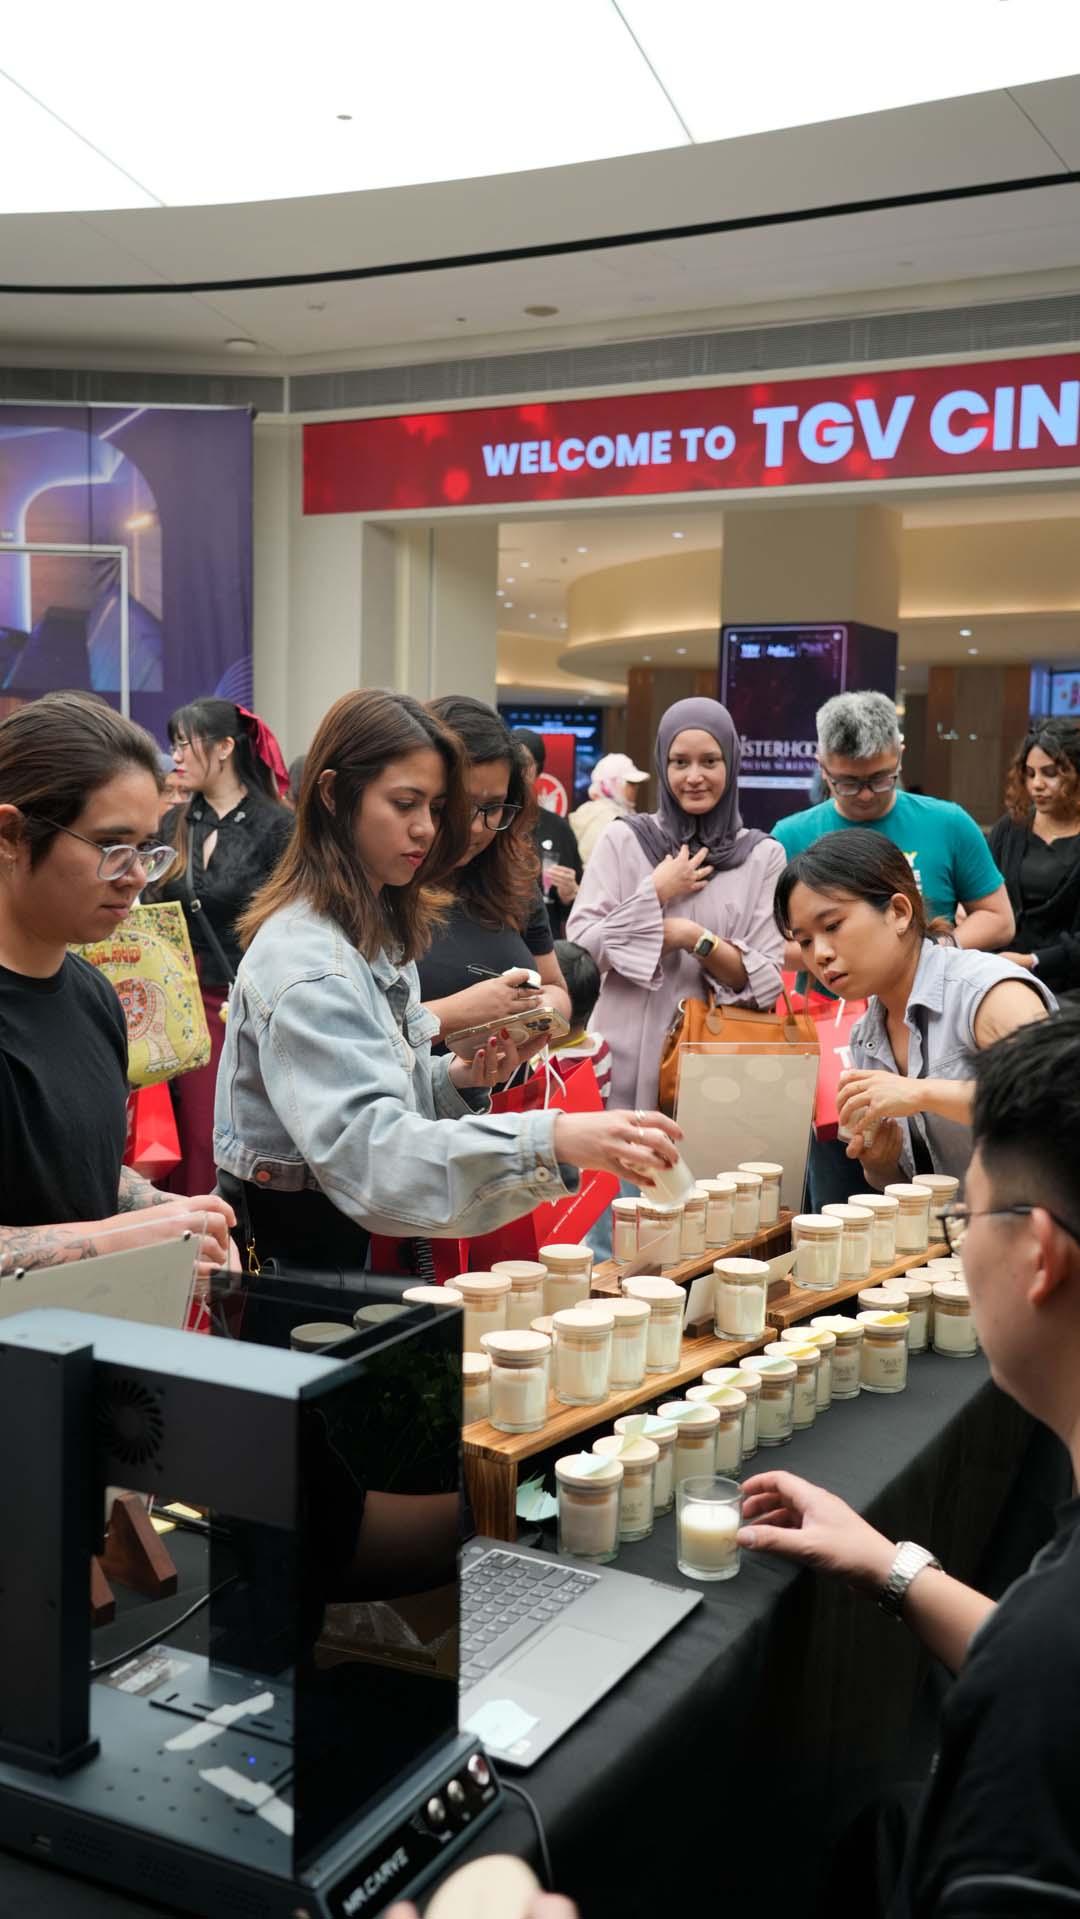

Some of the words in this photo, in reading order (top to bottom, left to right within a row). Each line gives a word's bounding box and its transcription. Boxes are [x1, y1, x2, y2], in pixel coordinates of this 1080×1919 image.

[482, 430, 673, 477] WELCOME
[679, 425, 736, 462] TO
[753, 395, 916, 468] TGV
[929, 380, 1080, 455] CIN
